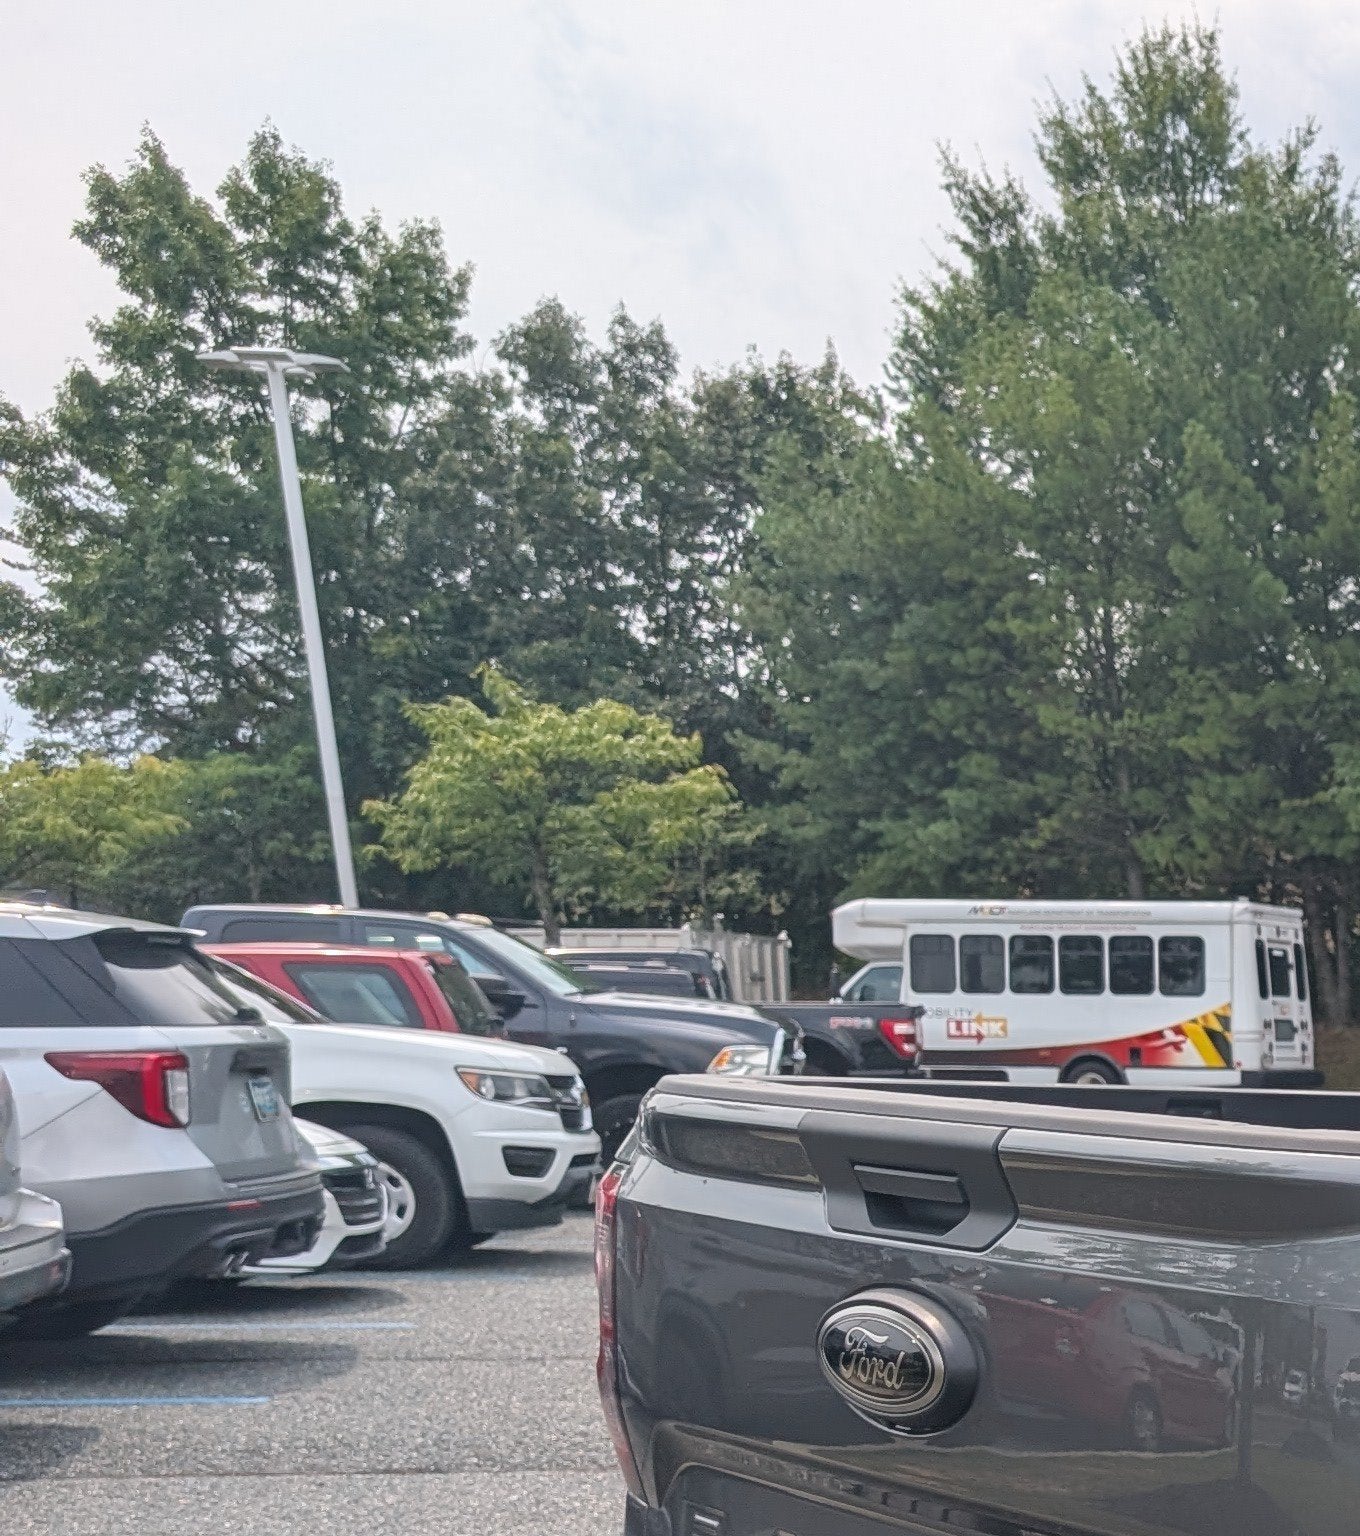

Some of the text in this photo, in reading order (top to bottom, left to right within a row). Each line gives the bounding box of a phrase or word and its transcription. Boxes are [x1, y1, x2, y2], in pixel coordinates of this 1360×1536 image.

[924, 1006, 973, 1017] OBILITY
[948, 1020, 1007, 1036] LINK
[839, 1326, 905, 1390] Ford
